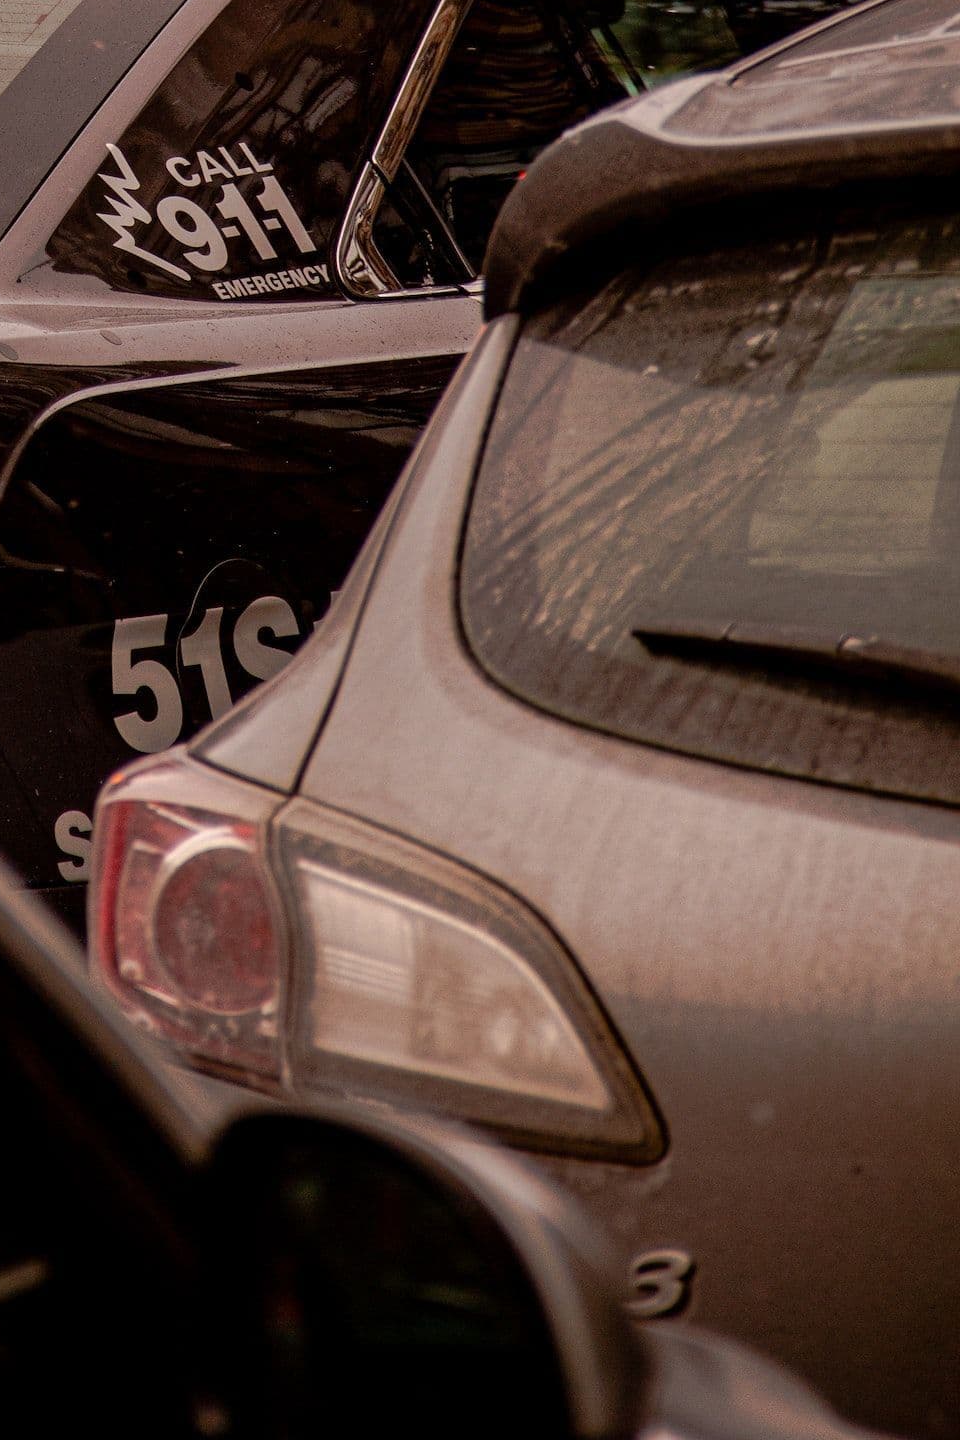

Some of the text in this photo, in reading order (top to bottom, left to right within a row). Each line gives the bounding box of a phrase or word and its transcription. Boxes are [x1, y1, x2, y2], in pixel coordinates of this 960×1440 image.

[165, 142, 273, 188] CALL
[211, 264, 332, 300] EMERGENCY
[111, 591, 340, 753] 51S
[623, 1249, 696, 1319] 3
